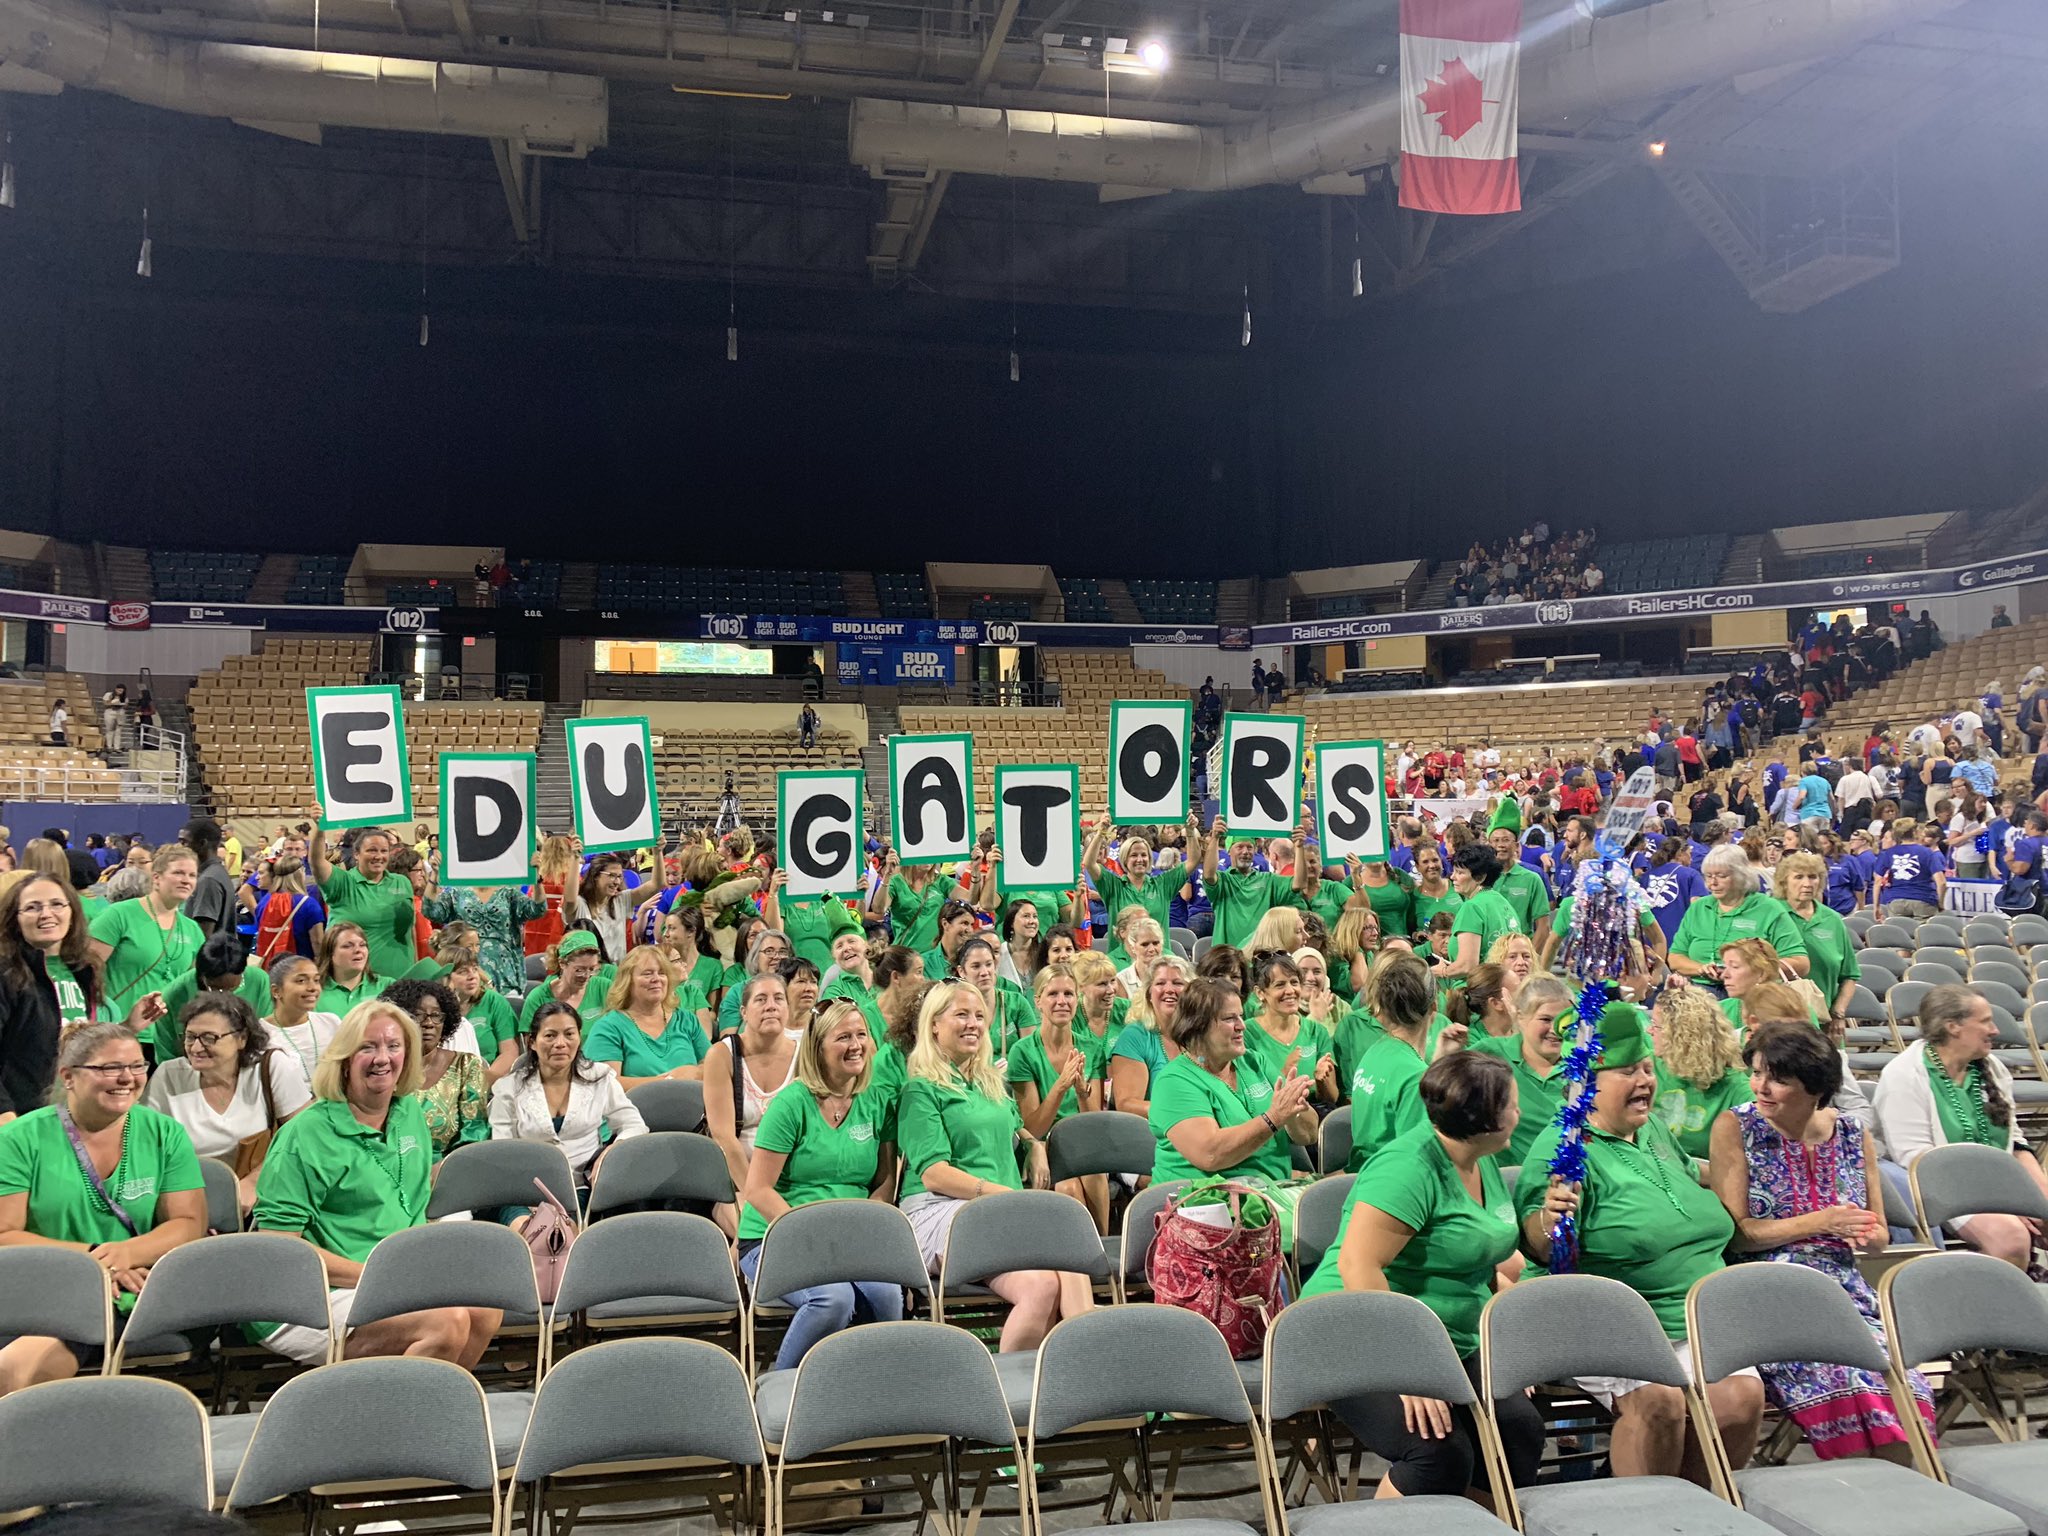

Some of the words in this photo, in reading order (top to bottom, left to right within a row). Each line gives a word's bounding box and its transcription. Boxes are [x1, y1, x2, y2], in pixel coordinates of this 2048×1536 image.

[1982, 564, 2035, 580] Gallagher
[1849, 581, 1920, 592] WORKERS
[41, 600, 91, 618] RAILERS
[112, 606, 145, 615] HONEY
[1628, 594, 1753, 614] RailersHC.com
[117, 613, 141, 621] DEW
[391, 611, 420, 628] 102
[756, 621, 774, 629] BUD
[1440, 613, 1483, 629] RAILERS
[712, 618, 739, 635] 103
[754, 628, 775, 636] LIGHT
[832, 622, 862, 634] BUD
[863, 623, 904, 635] LIGHT
[991, 625, 1015, 640] 104
[1292, 622, 1391, 640] RailersHC.com
[839, 661, 860, 670] BUD
[902, 652, 939, 665] BUD
[895, 664, 945, 678] LIGHT
[322, 711, 394, 804] E
[1118, 723, 1181, 803] O
[584, 742, 646, 831] U
[1230, 735, 1291, 822] R
[902, 756, 965, 846] A
[1327, 763, 1374, 842] S
[453, 776, 523, 863] D
[1001, 784, 1072, 867] T
[789, 793, 852, 879] G
